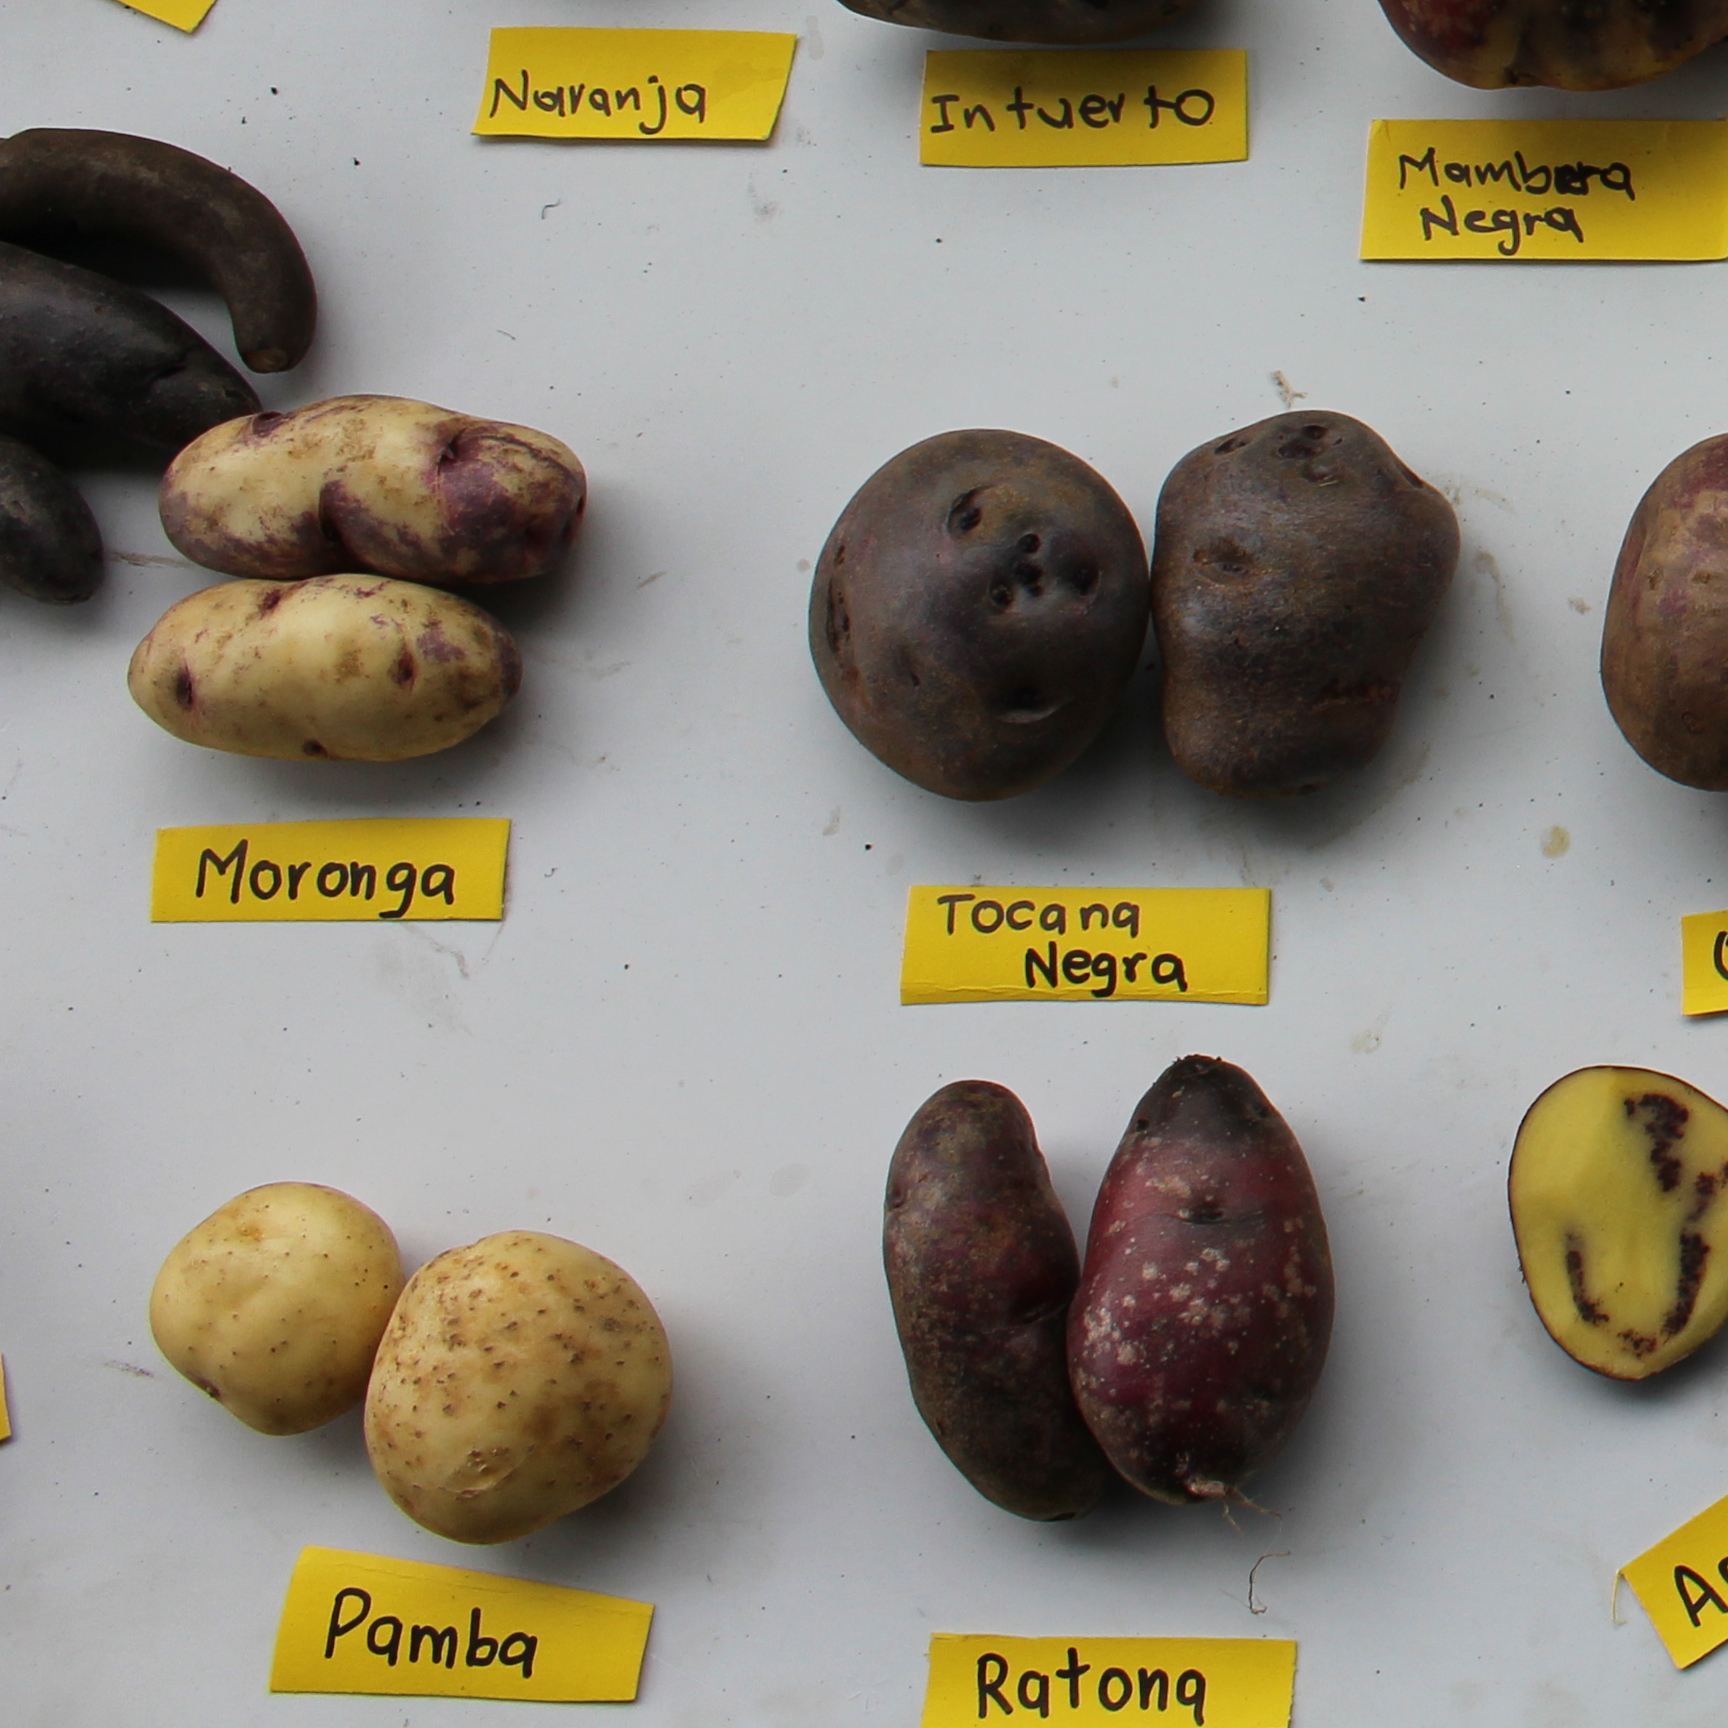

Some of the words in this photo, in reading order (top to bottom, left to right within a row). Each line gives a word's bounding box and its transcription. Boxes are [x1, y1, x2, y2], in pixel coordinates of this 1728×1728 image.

[489, 69, 706, 135] Naranja
[1420, 194, 1584, 256] Negra
[195, 838, 456, 918] Moronga
[936, 895, 1141, 938] Tocana
[1025, 942, 1188, 998] Negra
[325, 1586, 539, 1679] Pamba
[975, 1646, 1207, 1727] Ratona
